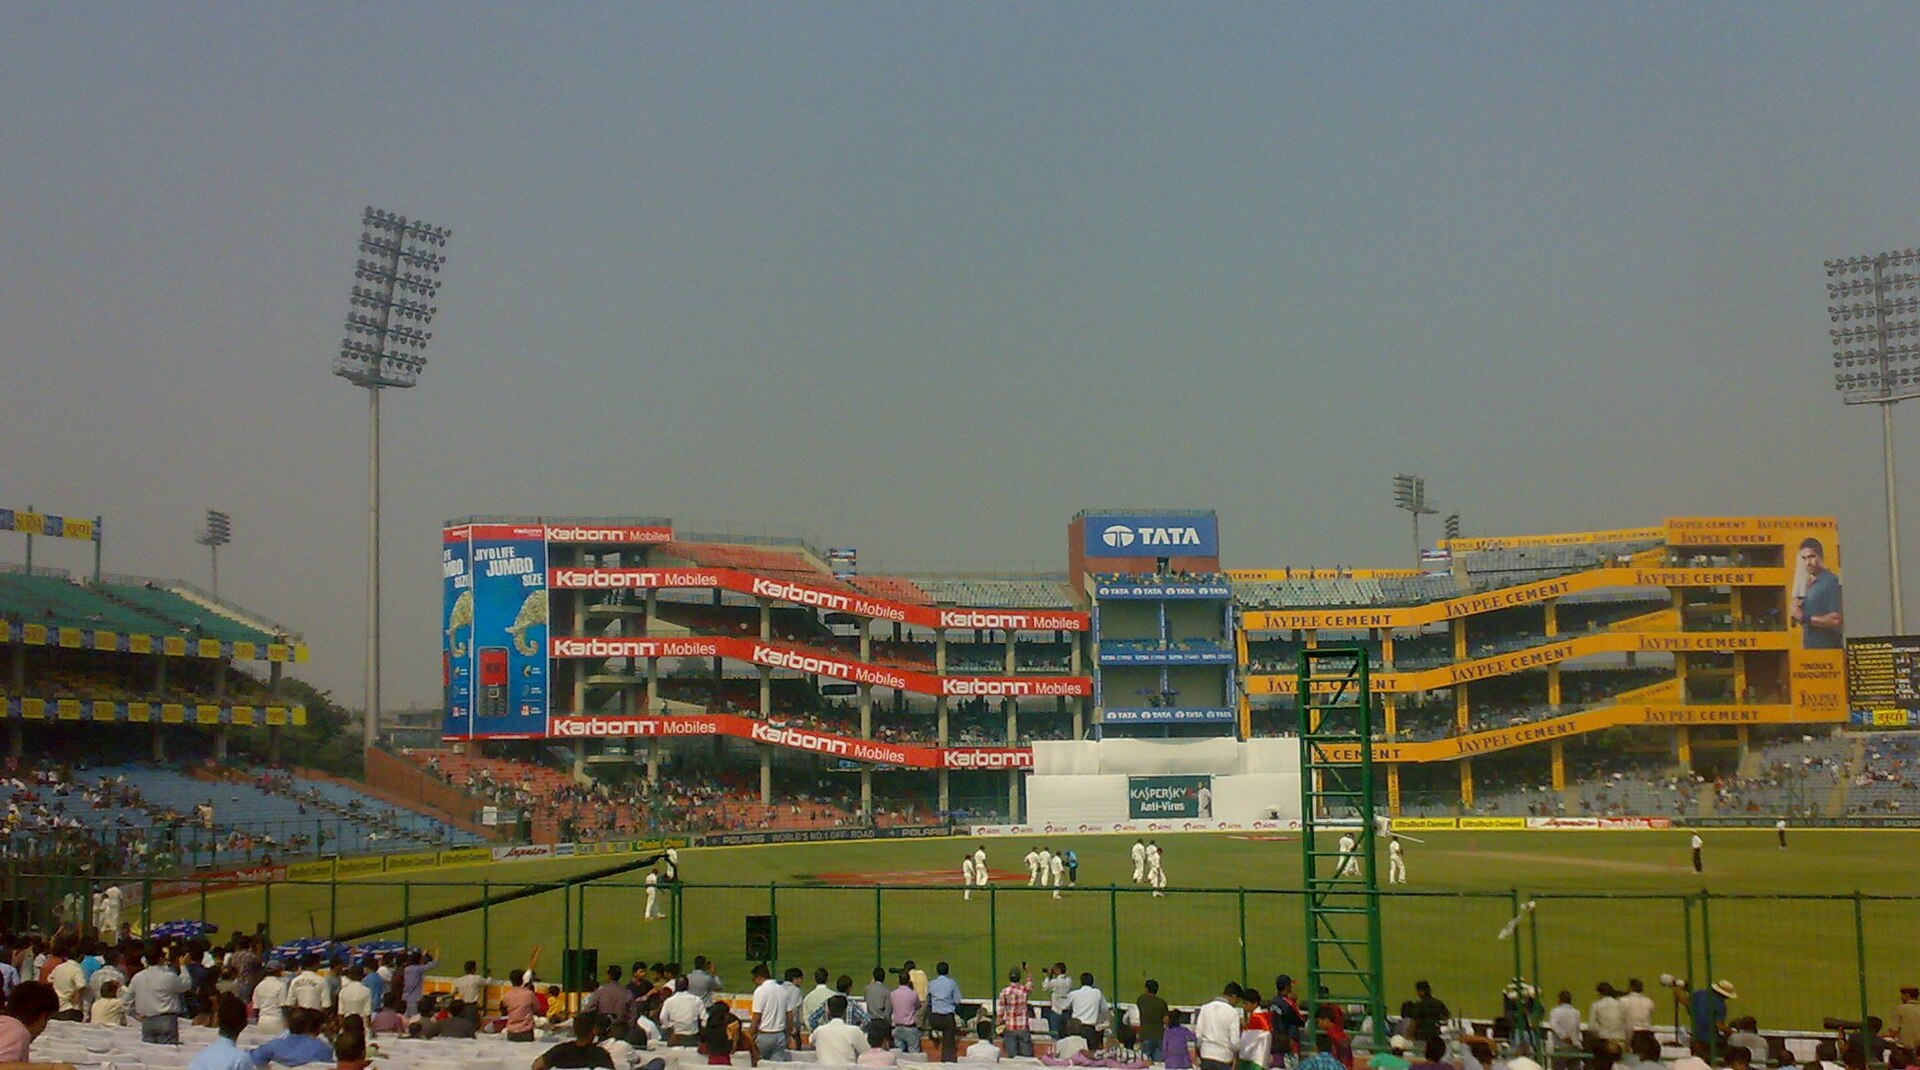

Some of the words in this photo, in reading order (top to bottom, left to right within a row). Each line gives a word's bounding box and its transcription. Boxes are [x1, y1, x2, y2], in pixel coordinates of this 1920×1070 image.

[546, 528, 624, 541] Karbonn
[630, 530, 670, 541] Mobiles
[1138, 528, 1200, 545] TATA
[1725, 534, 1772, 543] CEMENT
[496, 546, 516, 559] LIFE
[486, 557, 534, 576] JUMBO
[522, 572, 544, 587] SIZE
[556, 570, 658, 586] Karbonn
[664, 574, 718, 586] Mobiles
[1635, 569, 1690, 584] JAYPEE
[1694, 573, 1755, 584] CEMENT
[752, 578, 848, 610] Karbonn
[854, 600, 906, 621] Mobiles
[1444, 596, 1502, 618] JAYPEE
[1506, 582, 1570, 604] CEMENT
[940, 610, 1027, 628] Karbonn
[1033, 616, 1080, 629] Mobiles
[1263, 616, 1321, 629] JAYPEE
[1325, 614, 1392, 626] CEMENT
[554, 639, 656, 656] Karbonn
[664, 644, 716, 655] Mobiles
[1638, 634, 1690, 649] JAYPEE
[1696, 637, 1758, 648] CEMENT
[752, 646, 849, 678] Karbonn
[855, 668, 906, 688] Mobiles
[1450, 660, 1506, 682] JAYPEE
[1511, 646, 1574, 668] CEMENT
[942, 678, 1029, 694] Karbonn
[1035, 683, 1082, 695] Mobiles
[1643, 708, 1697, 722] JAYPEE
[1700, 710, 1759, 721] CEMENT
[554, 718, 656, 736] Karbonn
[663, 722, 716, 734] Mobiles
[752, 722, 847, 754] Karbonn
[854, 744, 905, 763] Mobiles
[1456, 734, 1510, 754] JAYPEE
[1516, 722, 1577, 742] CEMENT
[944, 750, 1030, 766] Karbonn
[1130, 786, 1187, 800] KASPERSKY
[1140, 802, 1186, 812] Anti-Virus
[722, 834, 765, 844] POLARIS
[850, 830, 875, 838] ROAD
[902, 828, 948, 837] POLARIS
